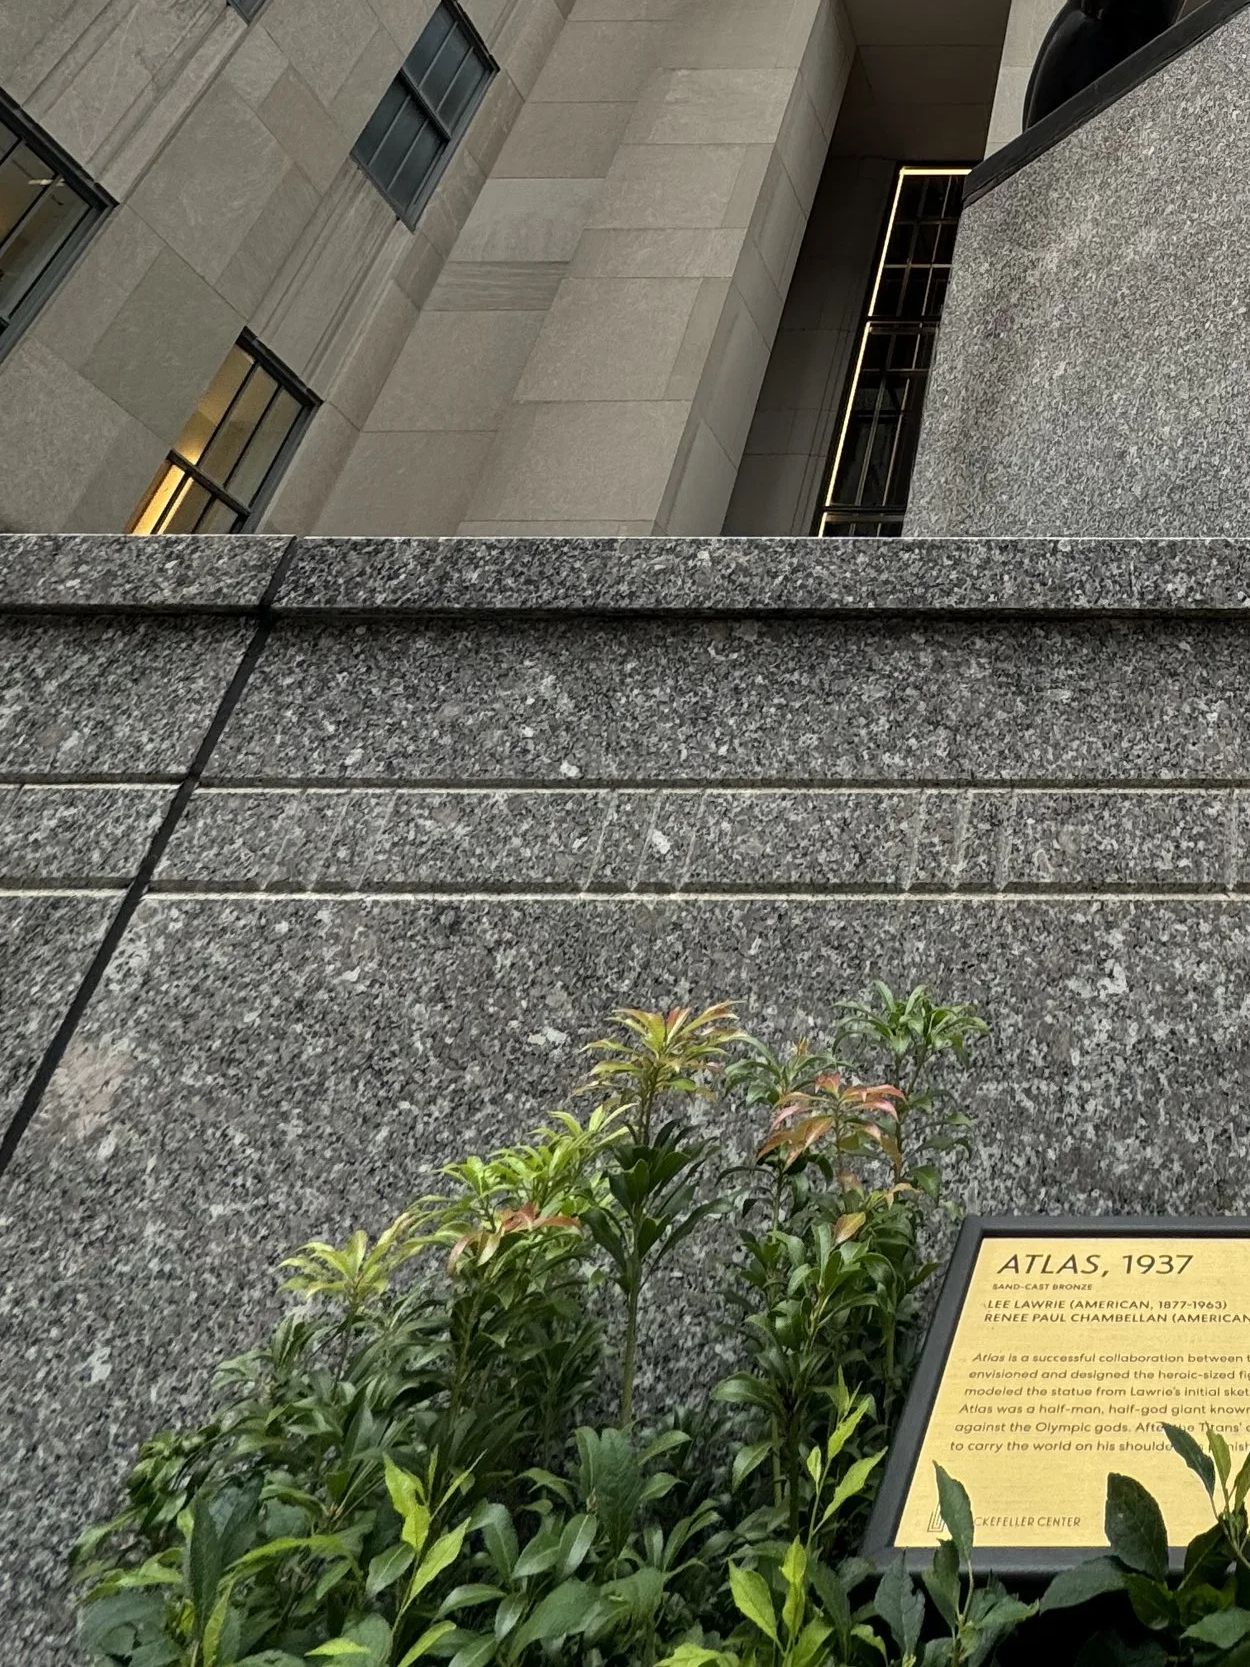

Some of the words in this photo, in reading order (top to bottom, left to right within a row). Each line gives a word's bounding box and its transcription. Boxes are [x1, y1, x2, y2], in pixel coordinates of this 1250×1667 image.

[996, 1254, 1110, 1278] ATLAS,
[1122, 1254, 1194, 1274] 1937
[992, 1283, 1051, 1291] SAND-CAST
[1052, 1283, 1093, 1291] BRONZE
[987, 1299, 1010, 1310] LEE
[1014, 1299, 1066, 1310] LAWRIE
[1070, 1299, 1154, 1312] (AMERICAN,
[1158, 1299, 1228, 1311] 1877-1963)
[984, 1313, 1028, 1323] RENEE
[1032, 1313, 1067, 1323] PAUL
[1071, 1313, 1168, 1323] CHAMBELLAN
[972, 1353, 1005, 1363] Atlas
[1008, 1353, 1018, 1363] is
[1020, 1355, 1029, 1363] a
[1032, 1353, 1096, 1363] successful
[1099, 1353, 1184, 1363] collaboration
[1188, 1353, 1244, 1363] between
[968, 1370, 1038, 1380] envisioned
[1041, 1370, 1067, 1380] and
[1070, 1370, 1130, 1382] designed
[1134, 1370, 1155, 1380] the
[1158, 1370, 1236, 1380] heroic-sized
[964, 1386, 1023, 1396] modeled
[1027, 1386, 1048, 1396] the
[1051, 1386, 1093, 1396] statue
[1096, 1386, 1127, 1396] from
[1130, 1386, 1181, 1396] Lawrie's
[1184, 1386, 1221, 1396] initial
[959, 1404, 993, 1414] Atlas
[996, 1406, 1023, 1414] was
[1026, 1406, 1035, 1414] a
[1039, 1404, 1104, 1416] half-man,
[1108, 1404, 1168, 1417] half-god
[1171, 1404, 1207, 1417] giant
[955, 1422, 1006, 1435] against
[1010, 1422, 1032, 1432] the
[1035, 1422, 1091, 1435] Olympic
[1094, 1422, 1132, 1435] gods.
[1135, 1422, 1166, 1432] Afte
[950, 1441, 964, 1451] to
[967, 1443, 1003, 1454] carry
[1006, 1441, 1030, 1451] the
[1032, 1441, 1072, 1451] world
[1075, 1443, 1093, 1451] on
[1096, 1441, 1116, 1451] his
[1118, 1441, 1175, 1451] shoulde
[974, 1517, 1035, 1527] CKEFELLER
[1037, 1517, 1081, 1527] CENTER
